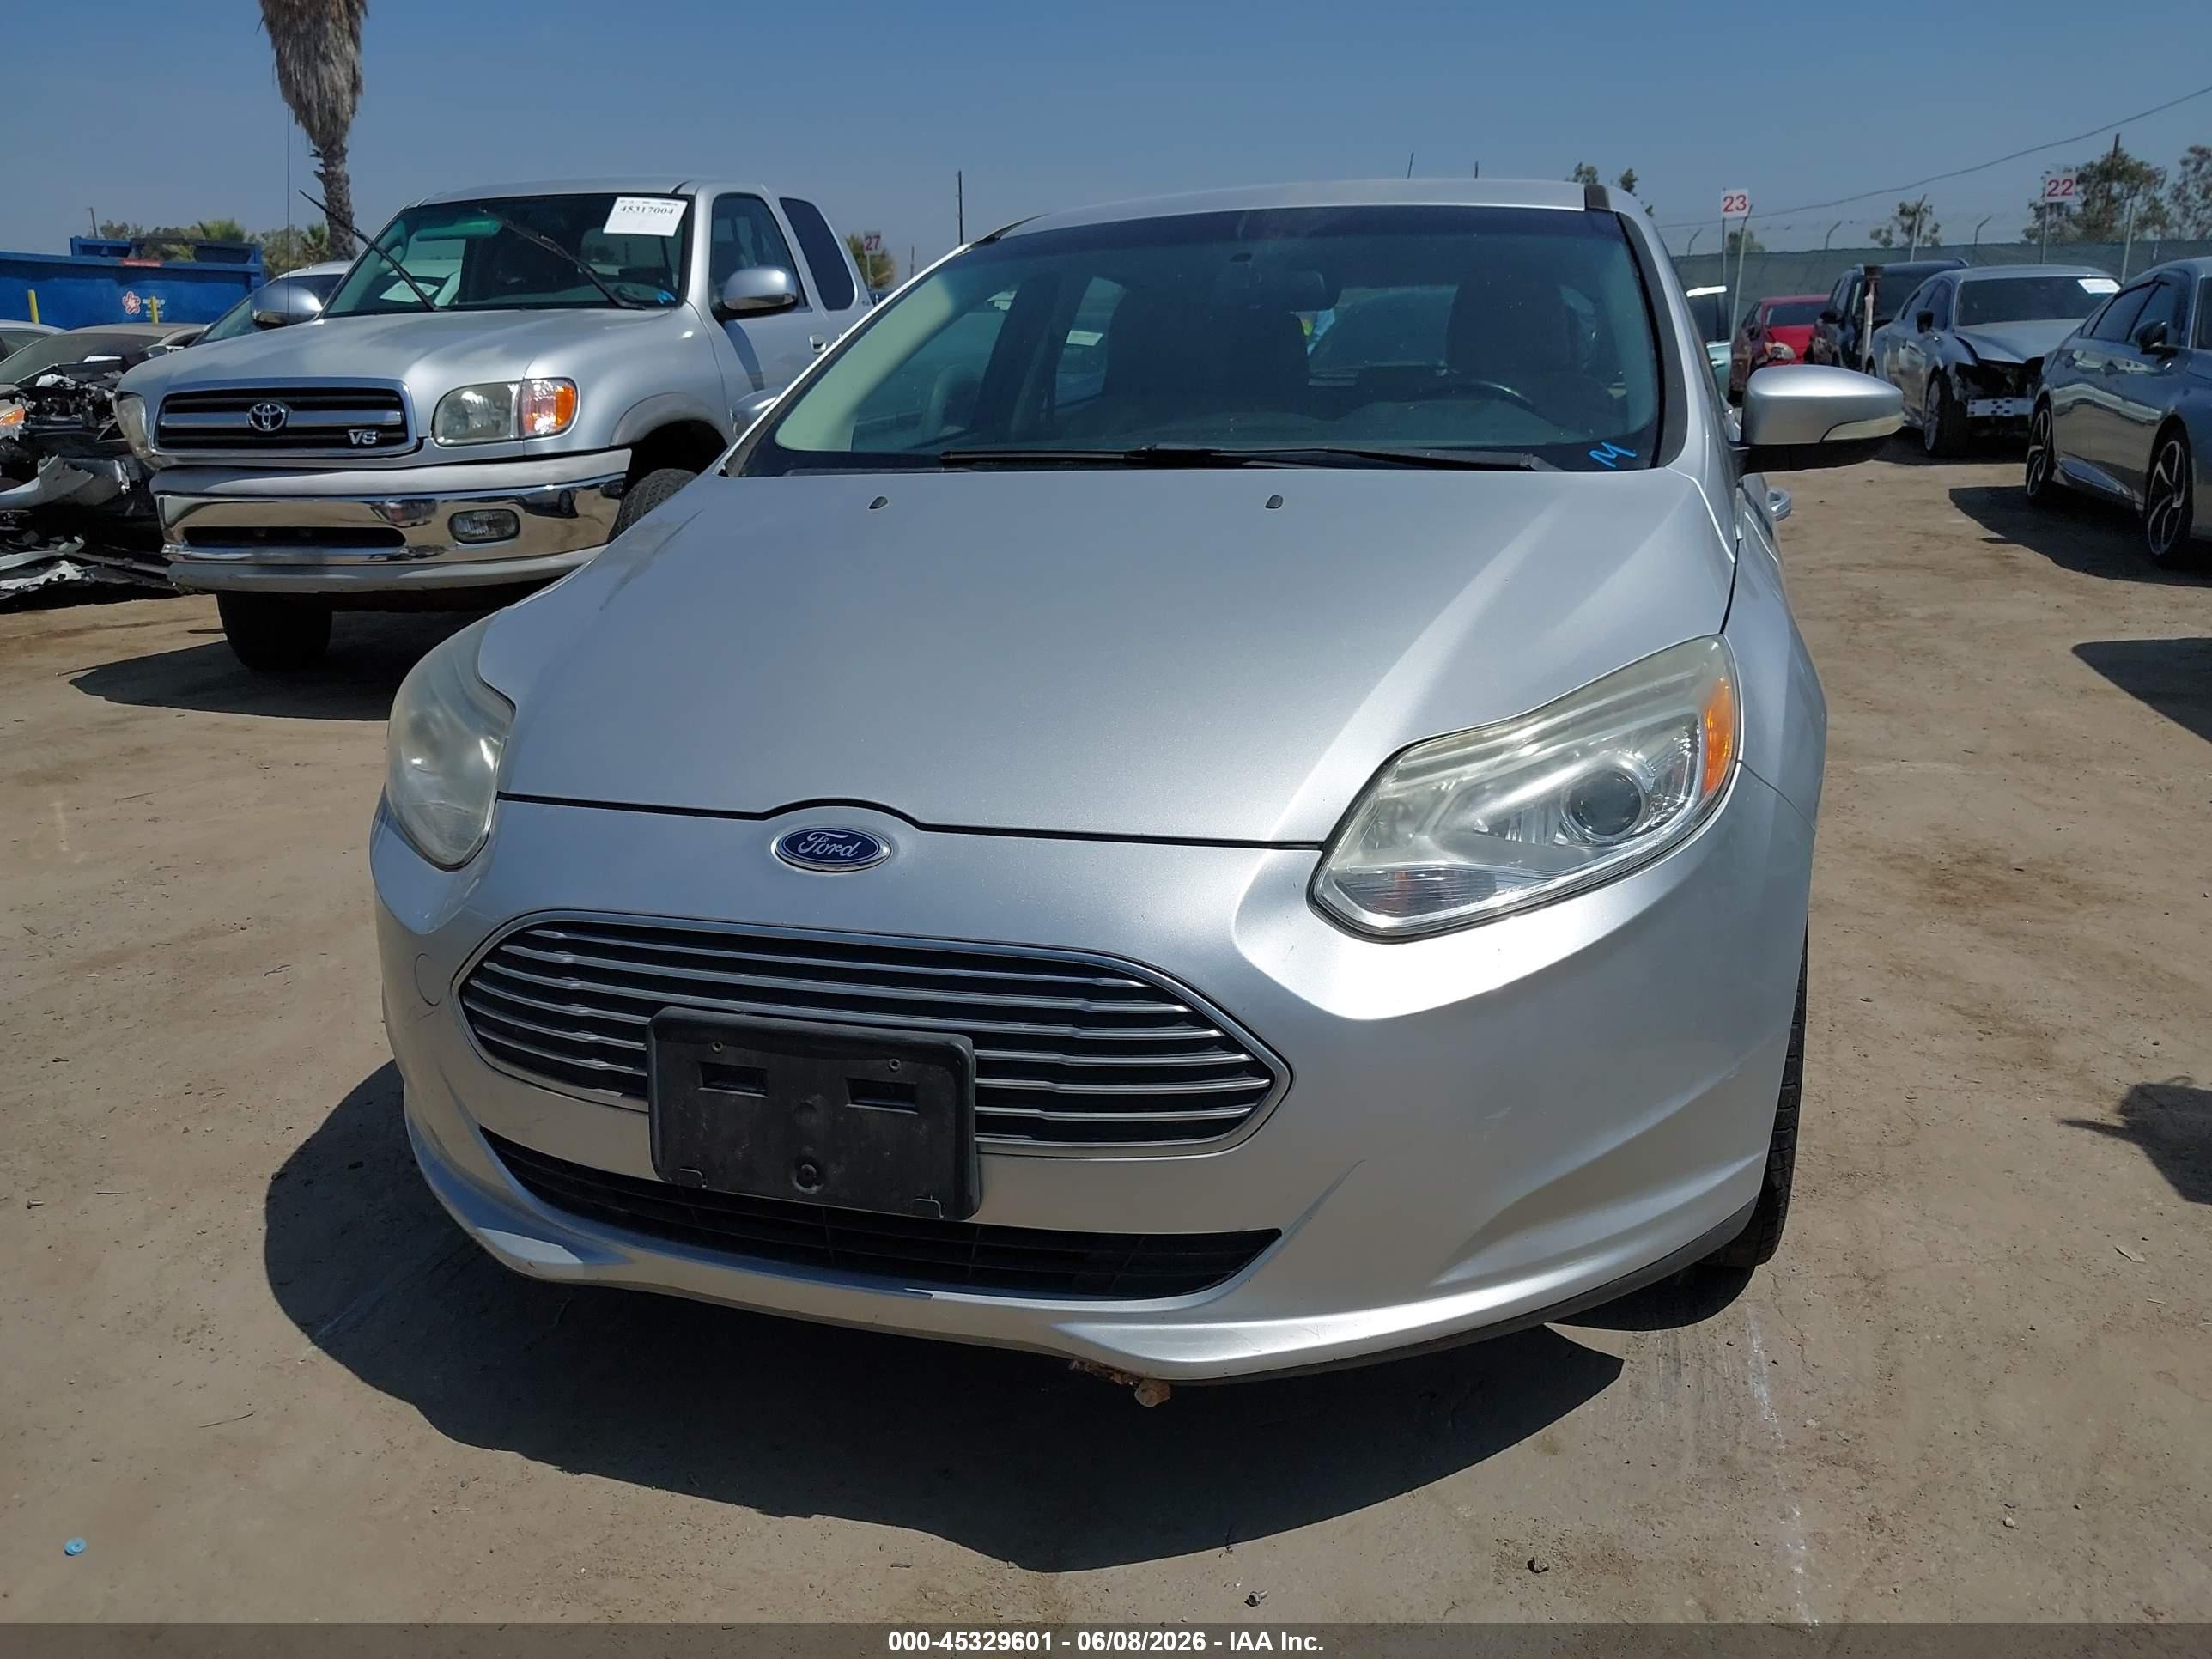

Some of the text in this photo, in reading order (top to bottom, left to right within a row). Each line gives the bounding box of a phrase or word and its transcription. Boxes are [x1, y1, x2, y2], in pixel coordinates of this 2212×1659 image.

[2047, 179, 2074, 197] 22
[1723, 194, 1747, 212] 23
[865, 234, 881, 251] 27
[348, 429, 378, 445] V8
[798, 831, 863, 857] Ford
